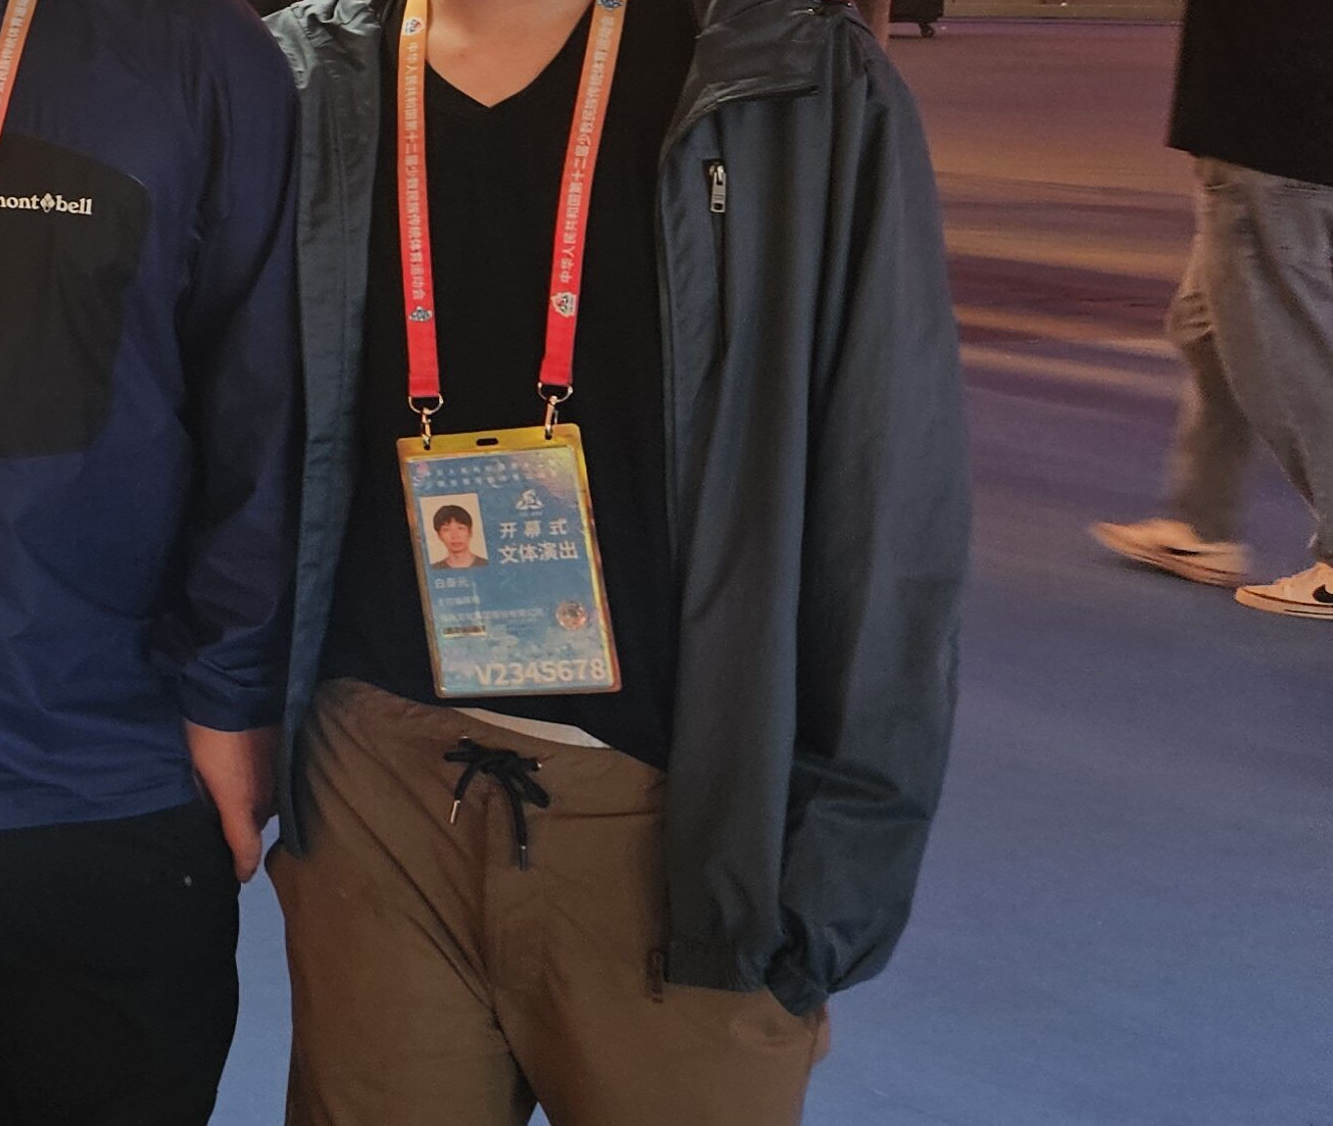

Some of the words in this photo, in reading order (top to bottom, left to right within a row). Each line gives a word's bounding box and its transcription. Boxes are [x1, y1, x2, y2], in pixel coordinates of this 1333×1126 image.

[404, 43, 425, 300] 中华人民共和国第十二届少数民族传统体育运动会
[499, 518, 568, 539] 开幕式
[497, 541, 579, 565] 文体演出
[476, 658, 607, 686] V2345678
